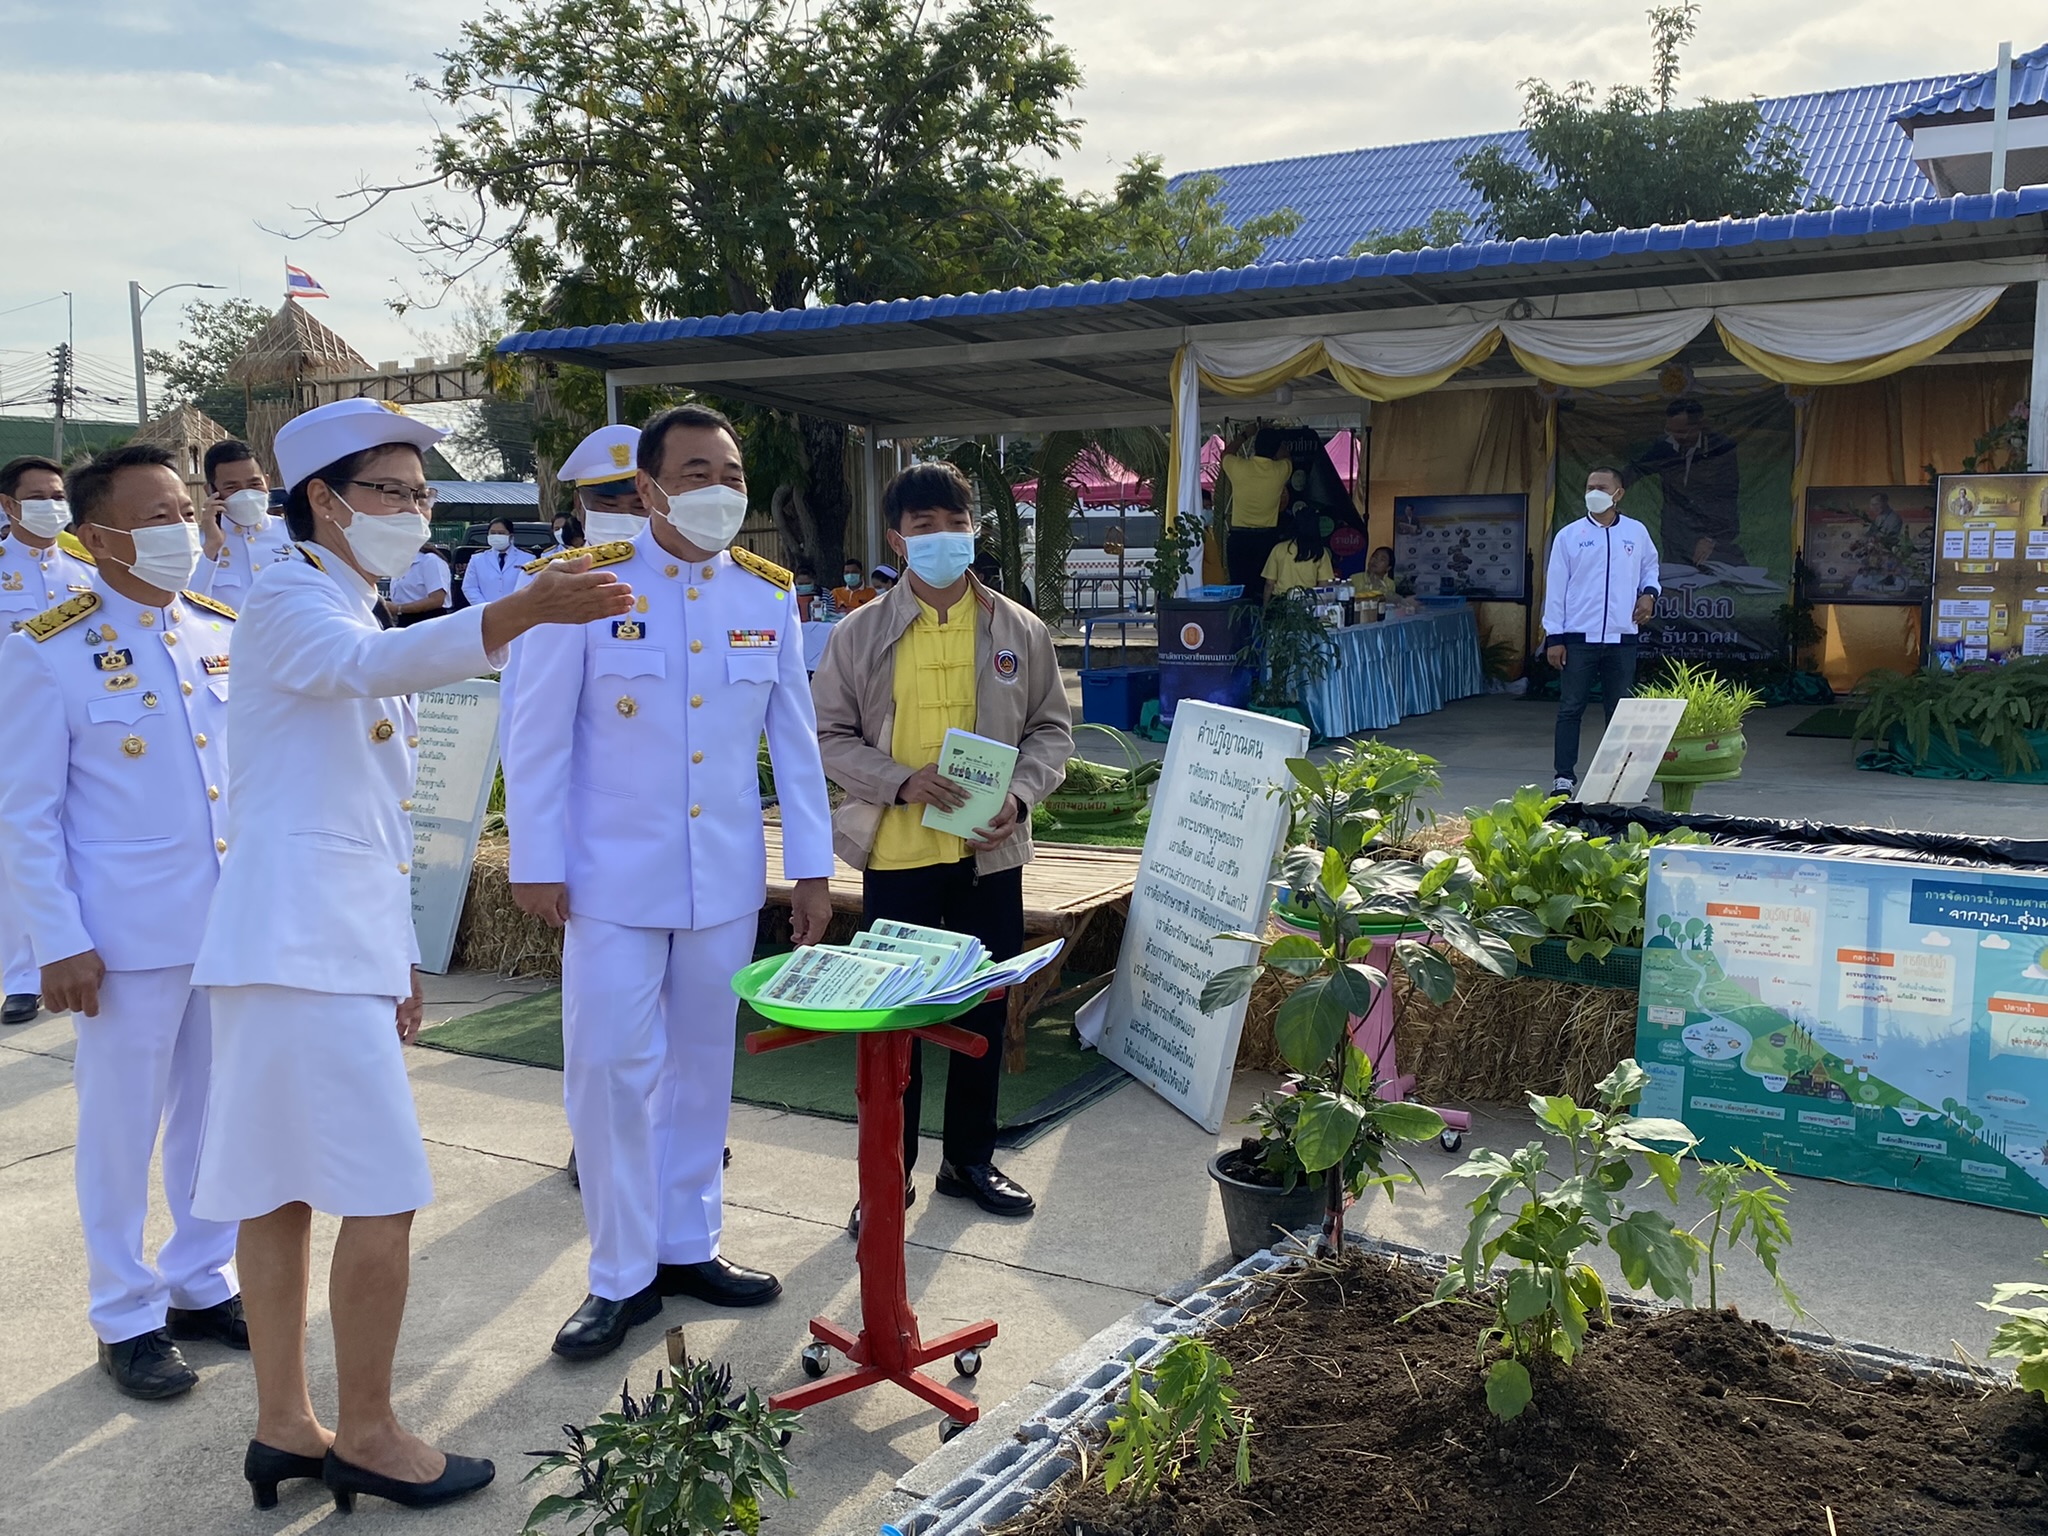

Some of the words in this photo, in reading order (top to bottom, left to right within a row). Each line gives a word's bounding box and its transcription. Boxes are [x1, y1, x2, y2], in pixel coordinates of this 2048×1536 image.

[1662, 625, 1739, 644] ธันวาคม
[1925, 889, 2048, 909] การจัดการน้ำตามศาส
[1145, 937, 1215, 983] ด้วยการทำเกษตรอินทรี์
